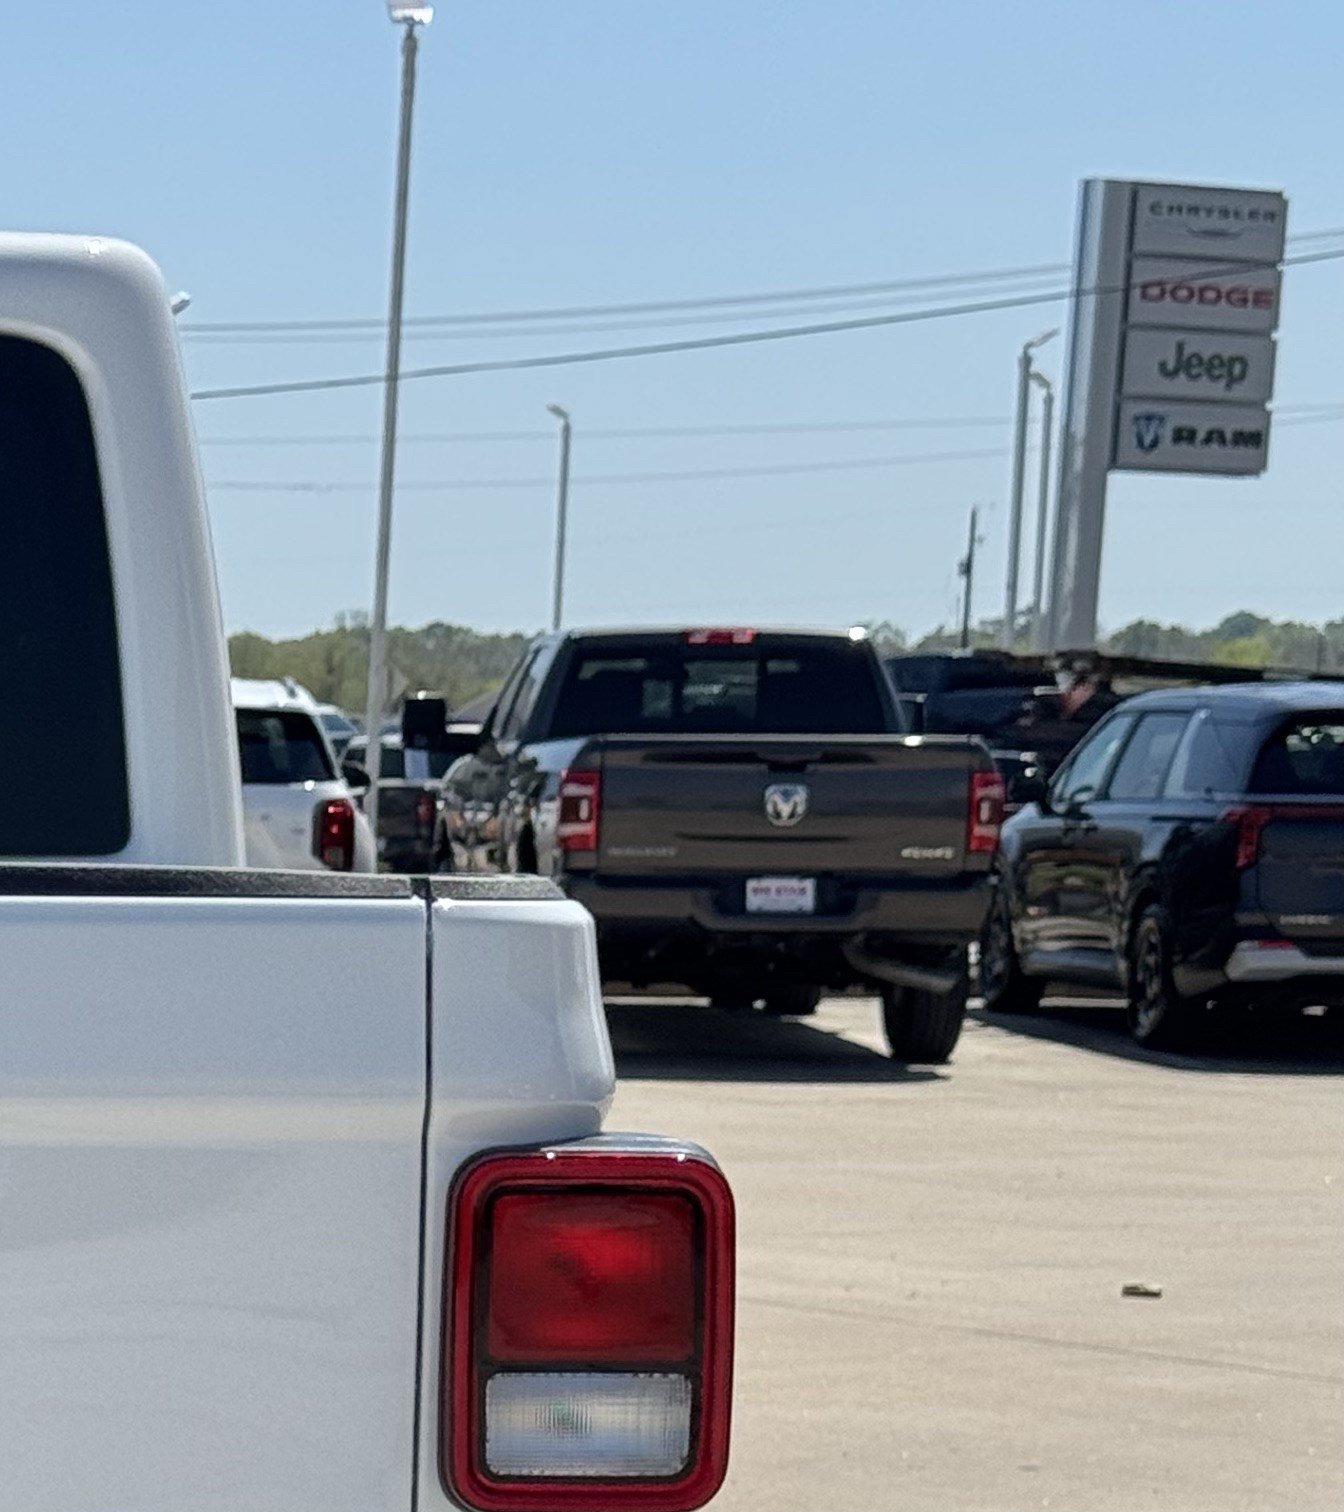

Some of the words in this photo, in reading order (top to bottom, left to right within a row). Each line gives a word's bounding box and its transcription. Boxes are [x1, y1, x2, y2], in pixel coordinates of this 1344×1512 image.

[1150, 202, 1278, 223] CHRYSLER
[1140, 279, 1274, 311] DODGE
[1158, 339, 1249, 391] Jeep
[1172, 425, 1263, 449] RAM
